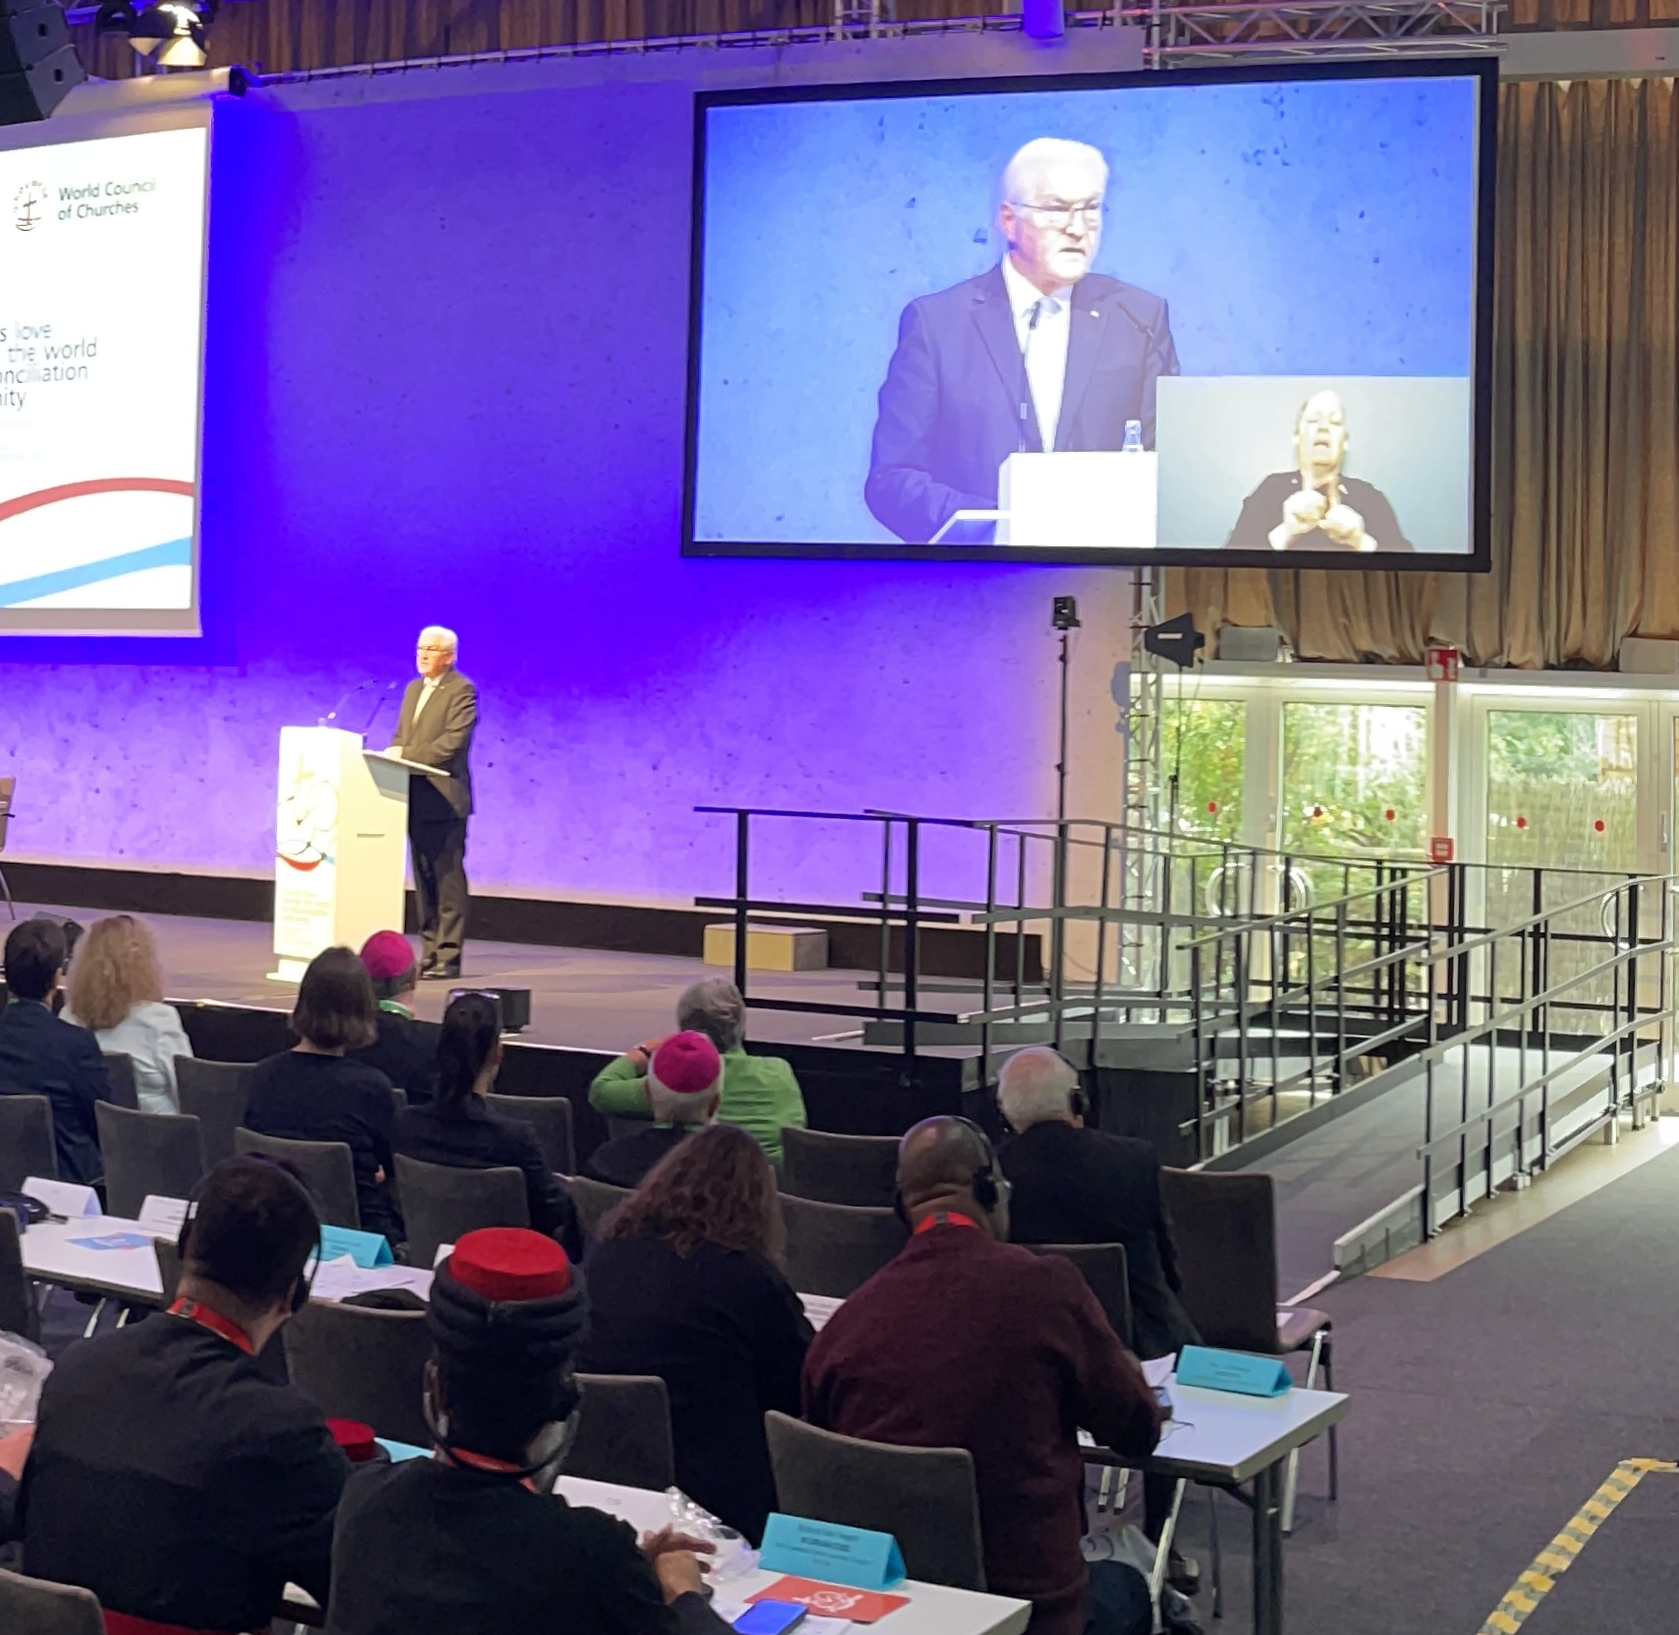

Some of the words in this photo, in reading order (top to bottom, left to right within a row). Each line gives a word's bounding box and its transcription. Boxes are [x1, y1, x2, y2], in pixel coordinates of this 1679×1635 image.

[58, 183, 100, 201] World
[104, 177, 157, 196] Council
[57, 204, 72, 221] of
[76, 200, 139, 219] Churches
[14, 320, 53, 340] love
[7, 341, 37, 364] the
[44, 337, 98, 360] world
